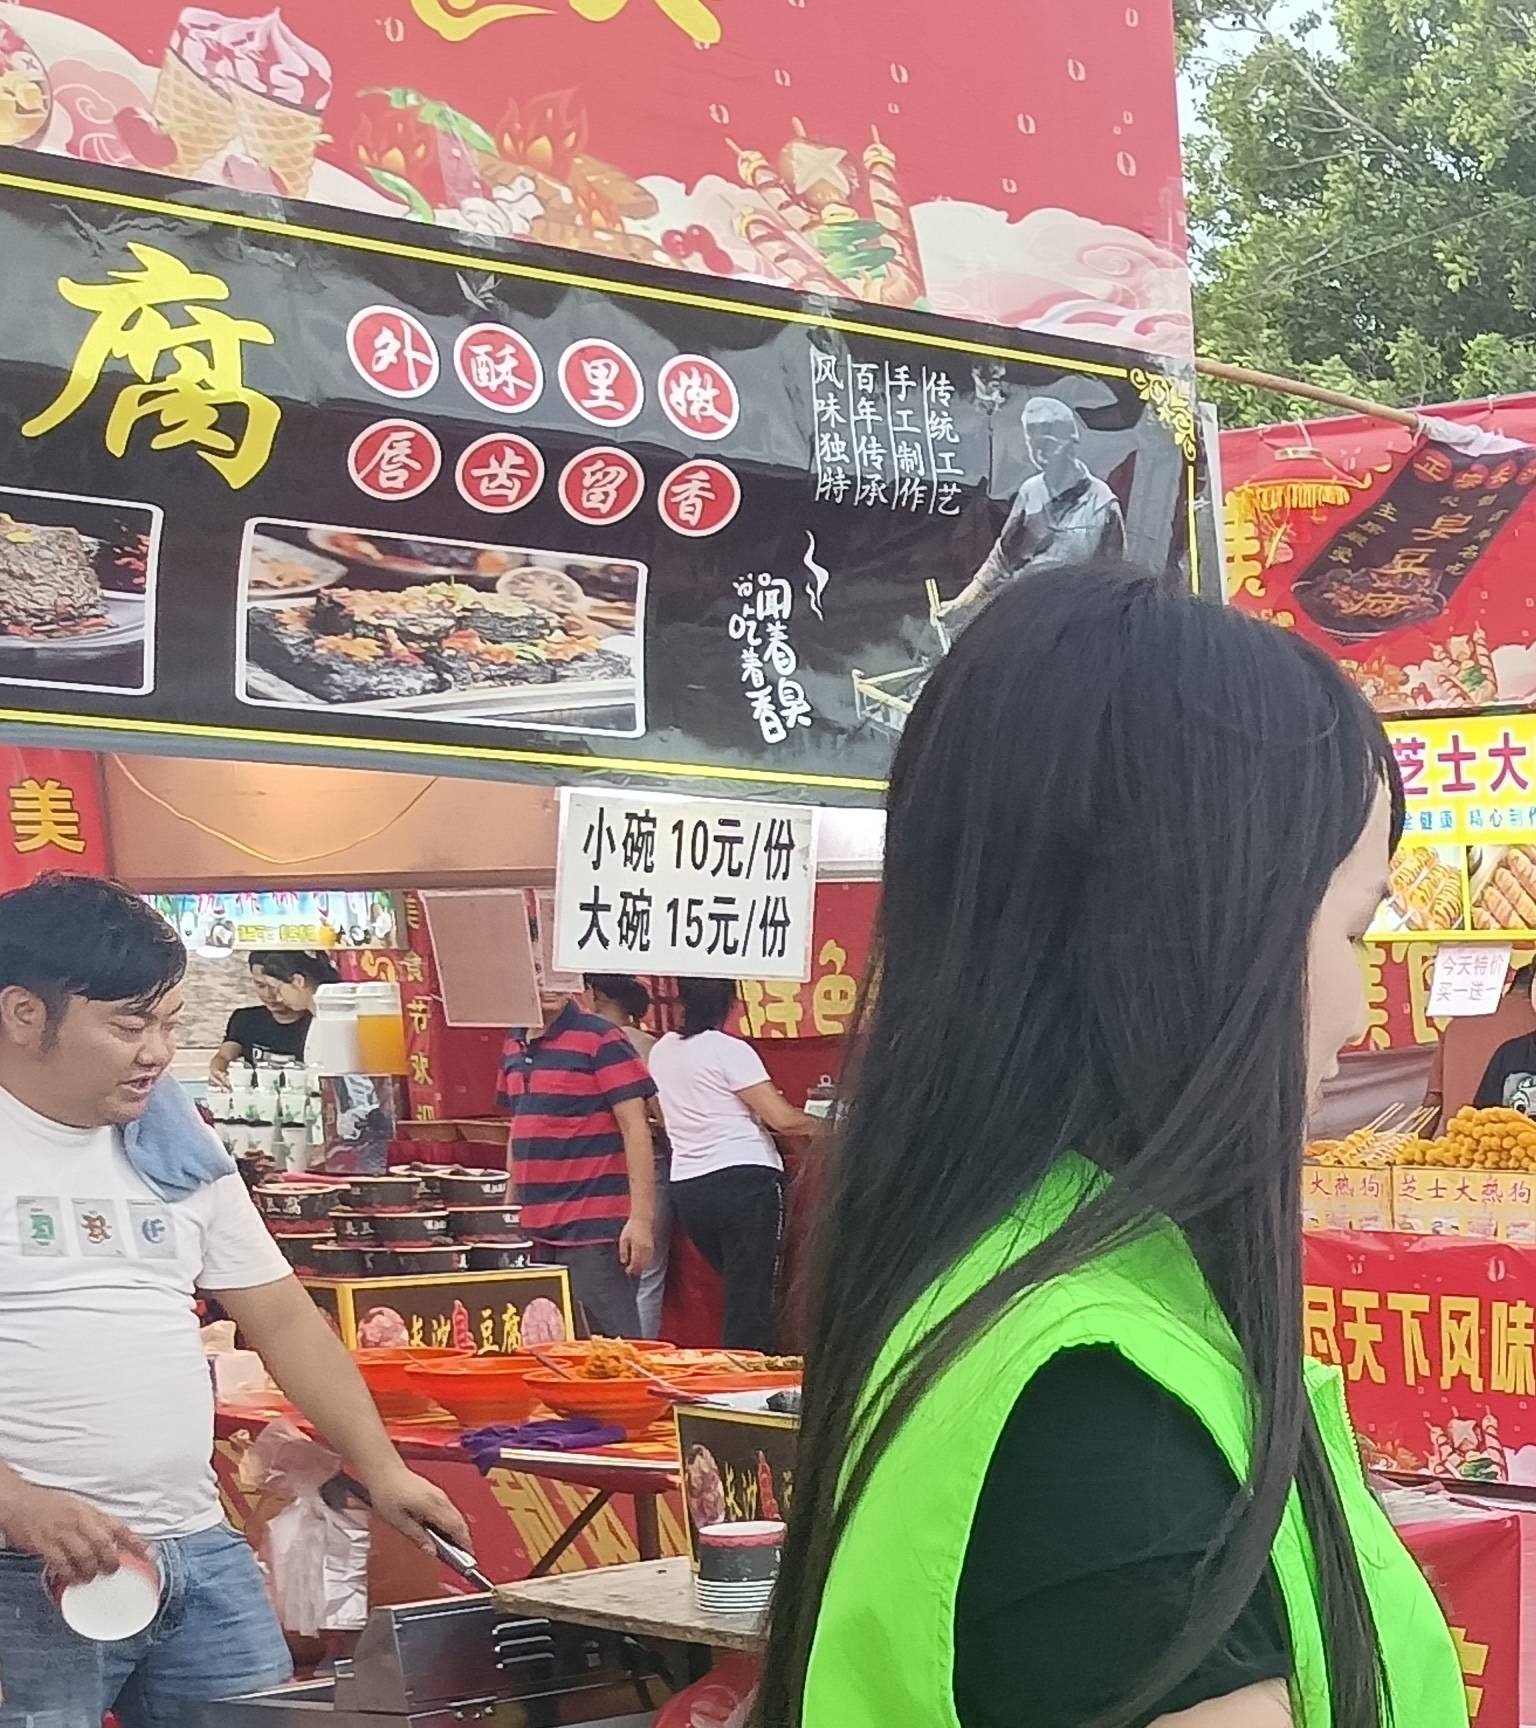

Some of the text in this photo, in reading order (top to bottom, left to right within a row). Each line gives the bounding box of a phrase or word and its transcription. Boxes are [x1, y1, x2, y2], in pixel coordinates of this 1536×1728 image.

[21, 242, 279, 490] 腐
[372, 319, 730, 425] 外酥里嫩
[356, 431, 716, 527] 唇齿留香
[816, 354, 852, 504] 风味独特
[853, 362, 888, 508] 百年传承
[890, 366, 928, 512] 手工制作
[927, 371, 964, 516] 传统工艺
[9, 777, 87, 855] 美
[582, 808, 796, 880] 小碗 10元/份
[577, 885, 791, 962] 大碗 15元/份
